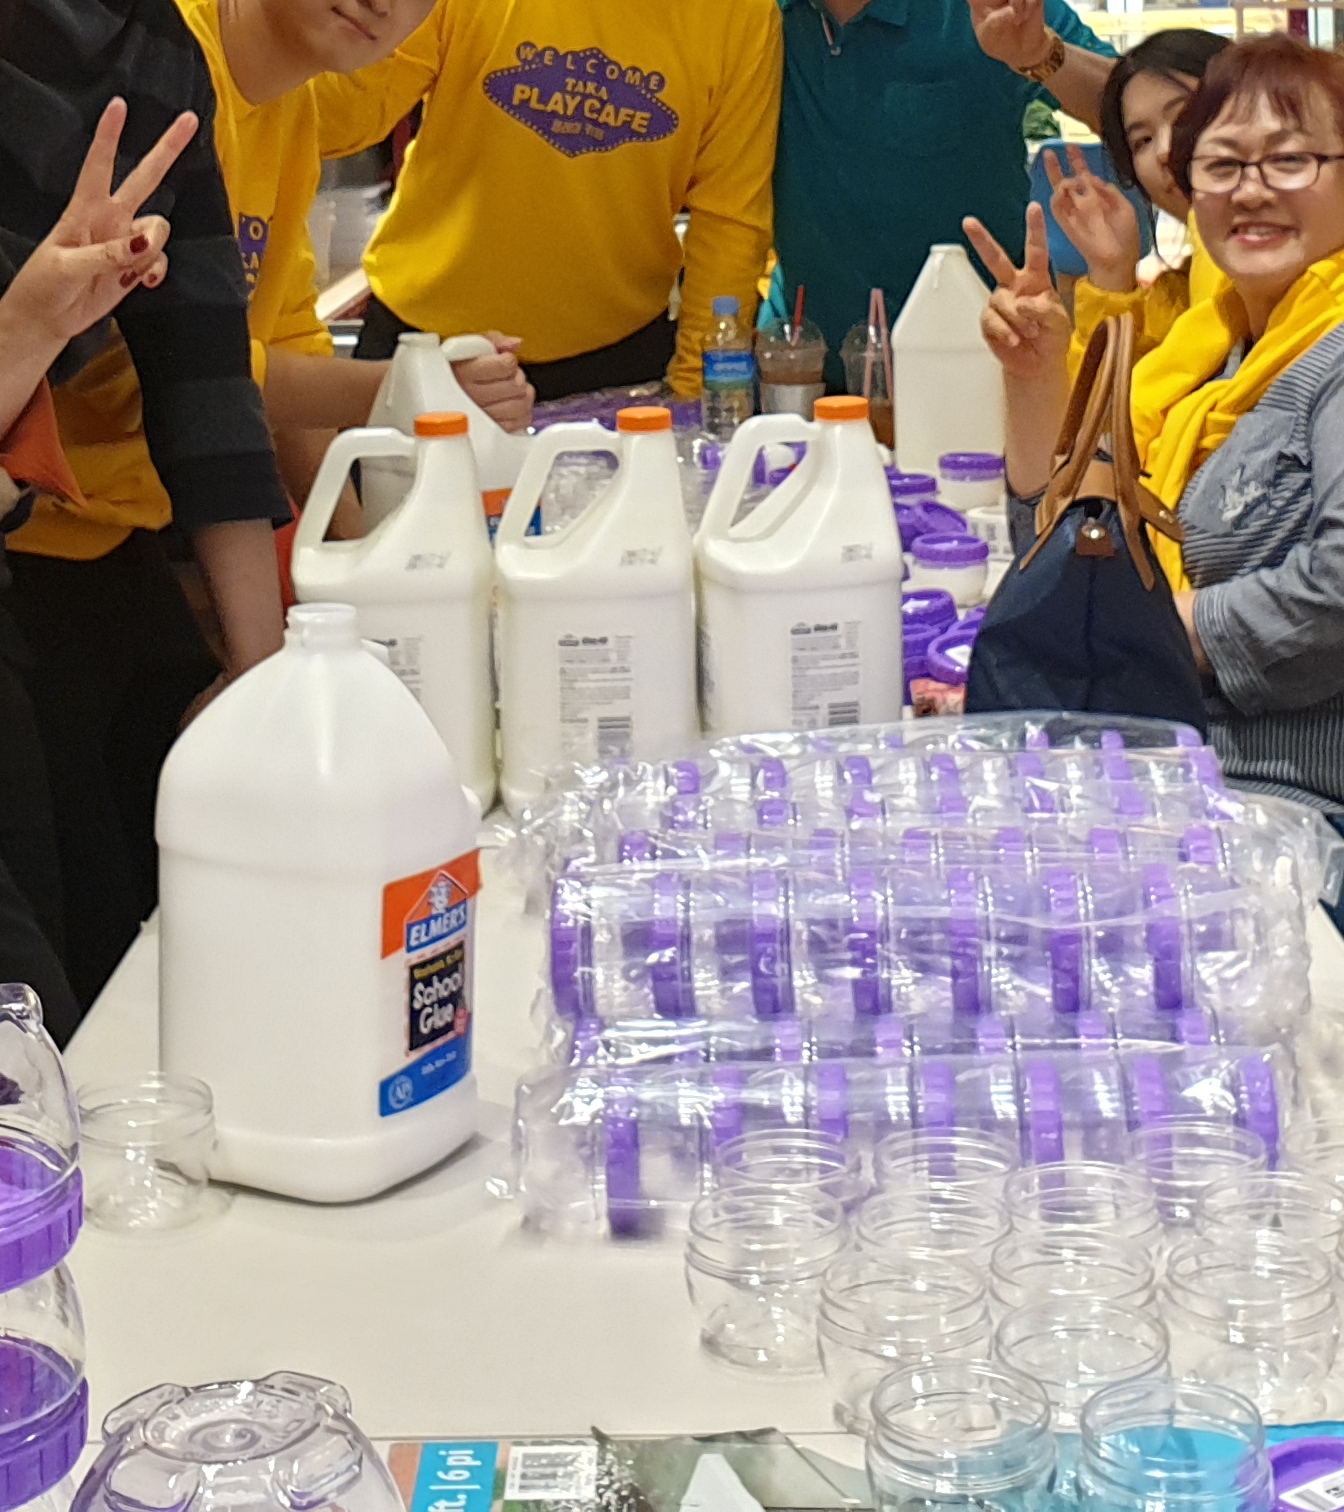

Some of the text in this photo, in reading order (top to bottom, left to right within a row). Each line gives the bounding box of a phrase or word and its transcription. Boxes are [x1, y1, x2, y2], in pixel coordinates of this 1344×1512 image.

[519, 44, 660, 91] WELCOME
[511, 84, 581, 116] PLAY
[583, 98, 652, 134] CAFE
[413, 962, 463, 1010] School
[419, 1002, 455, 1035] Glue
[437, 1449, 483, 1467] pi
